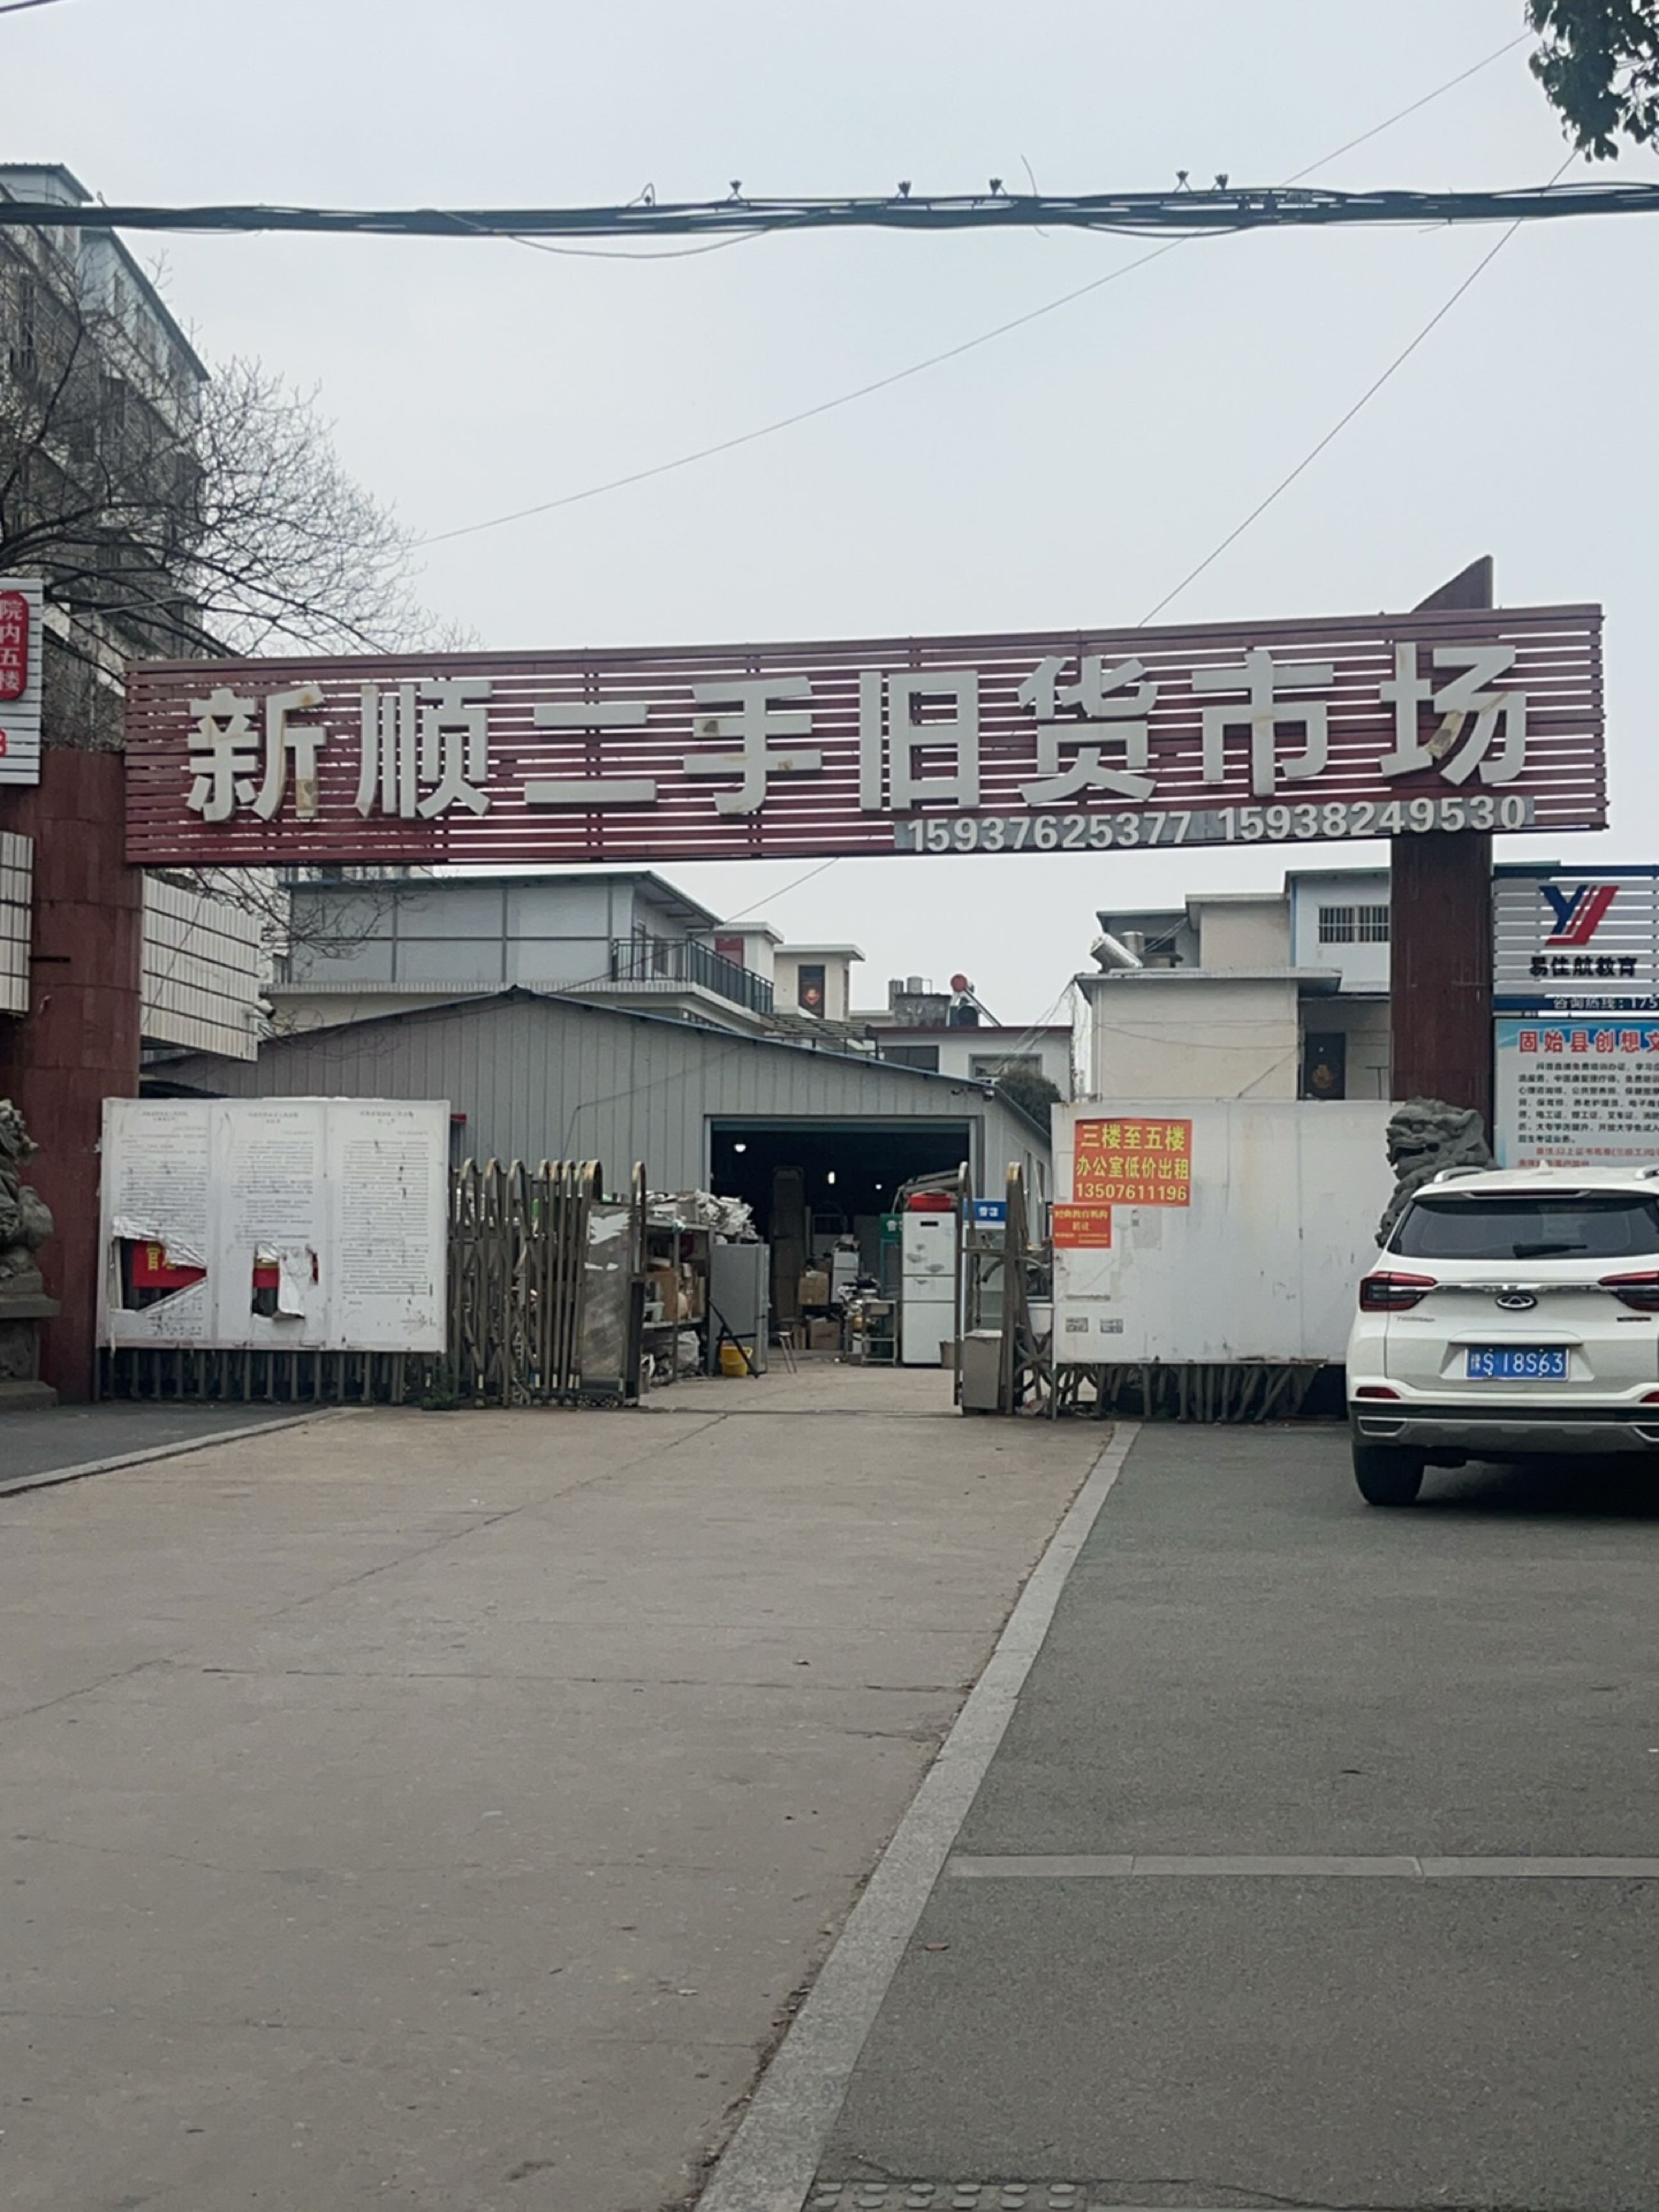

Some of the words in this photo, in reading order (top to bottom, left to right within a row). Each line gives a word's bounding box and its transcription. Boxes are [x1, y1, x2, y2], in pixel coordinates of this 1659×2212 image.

[185, 641, 1527, 822] 新顺二手旧货市场
[908, 810, 1192, 853] 15937625377
[1216, 795, 1527, 843] 15938249530
[1081, 1123, 1185, 1151] 三楼至五楼
[1077, 1155, 1189, 1180] 办公室低价出租
[1076, 1182, 1187, 1201] 13507611196
